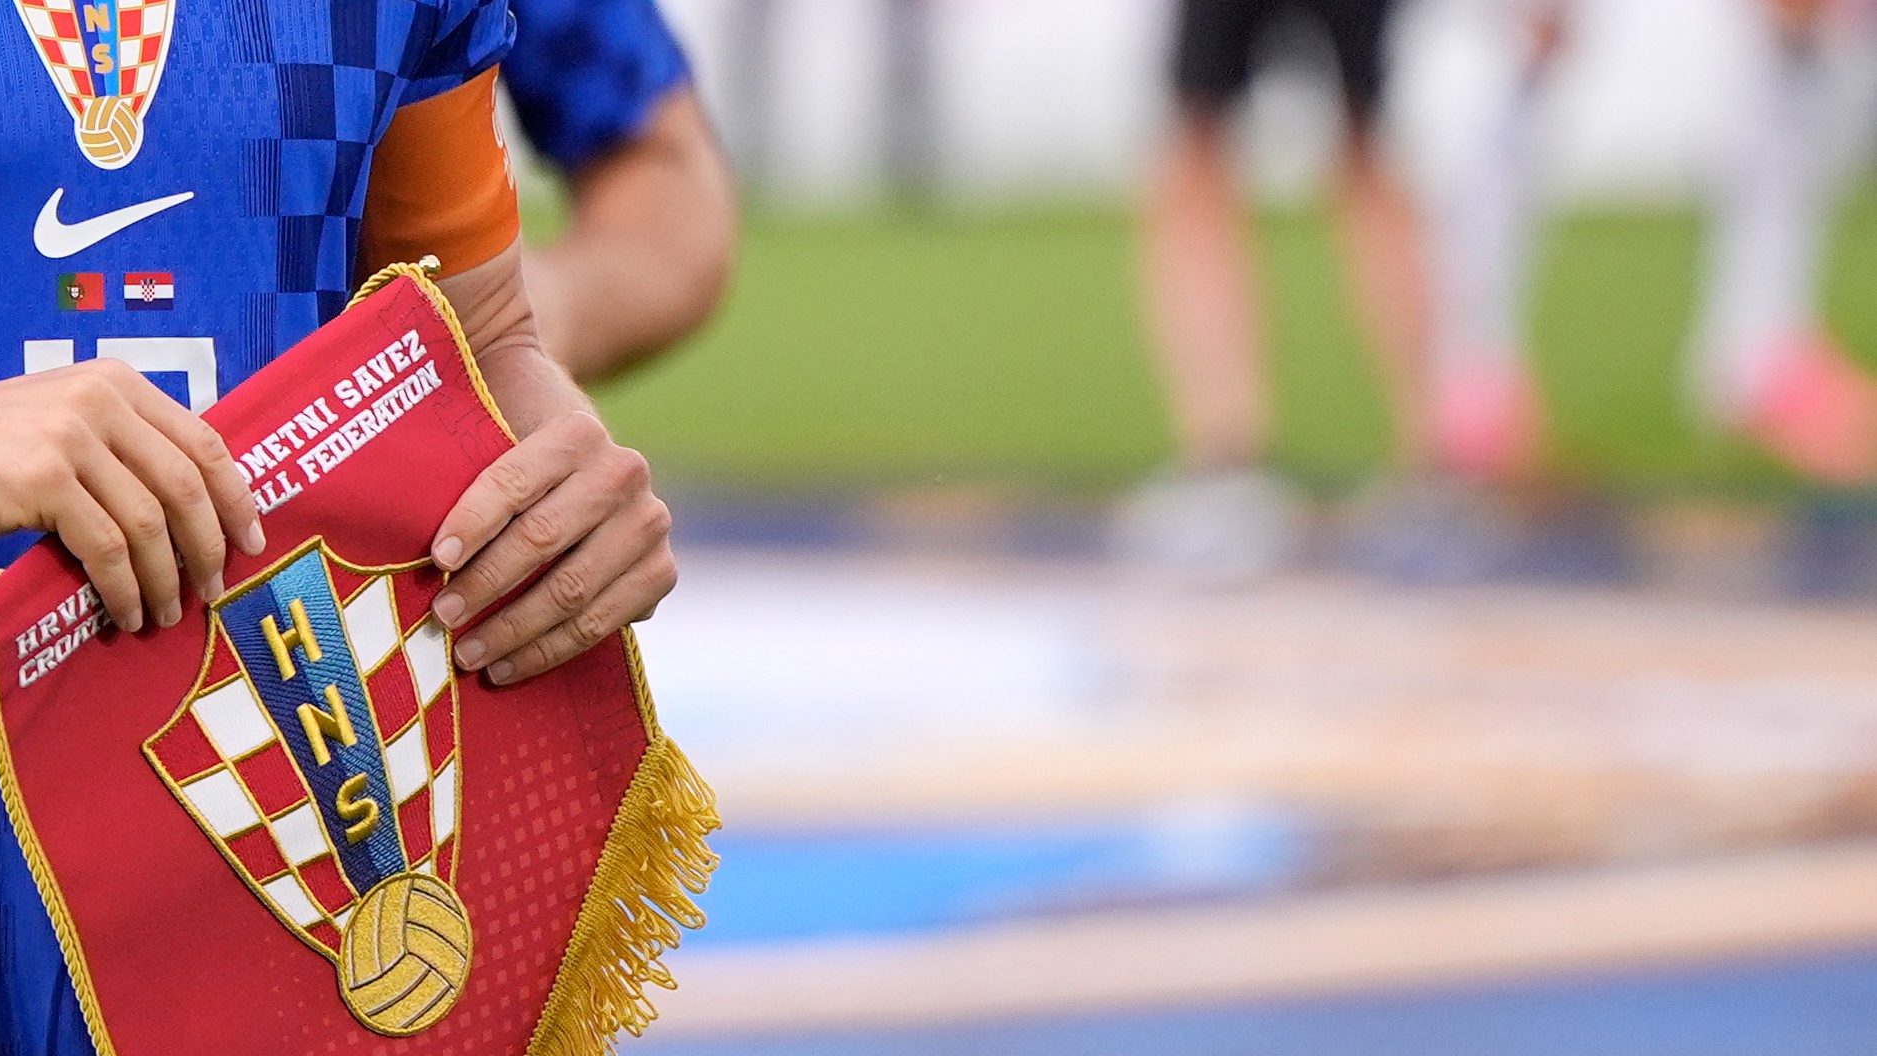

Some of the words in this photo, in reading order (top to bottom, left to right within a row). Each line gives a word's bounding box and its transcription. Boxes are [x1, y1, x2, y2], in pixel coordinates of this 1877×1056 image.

[15, 582, 100, 659] HRVA
[334, 329, 427, 409] SAVEZ
[18, 608, 112, 688] CROAT
[296, 360, 443, 484] FEDERATION
[260, 598, 380, 845] HNS
